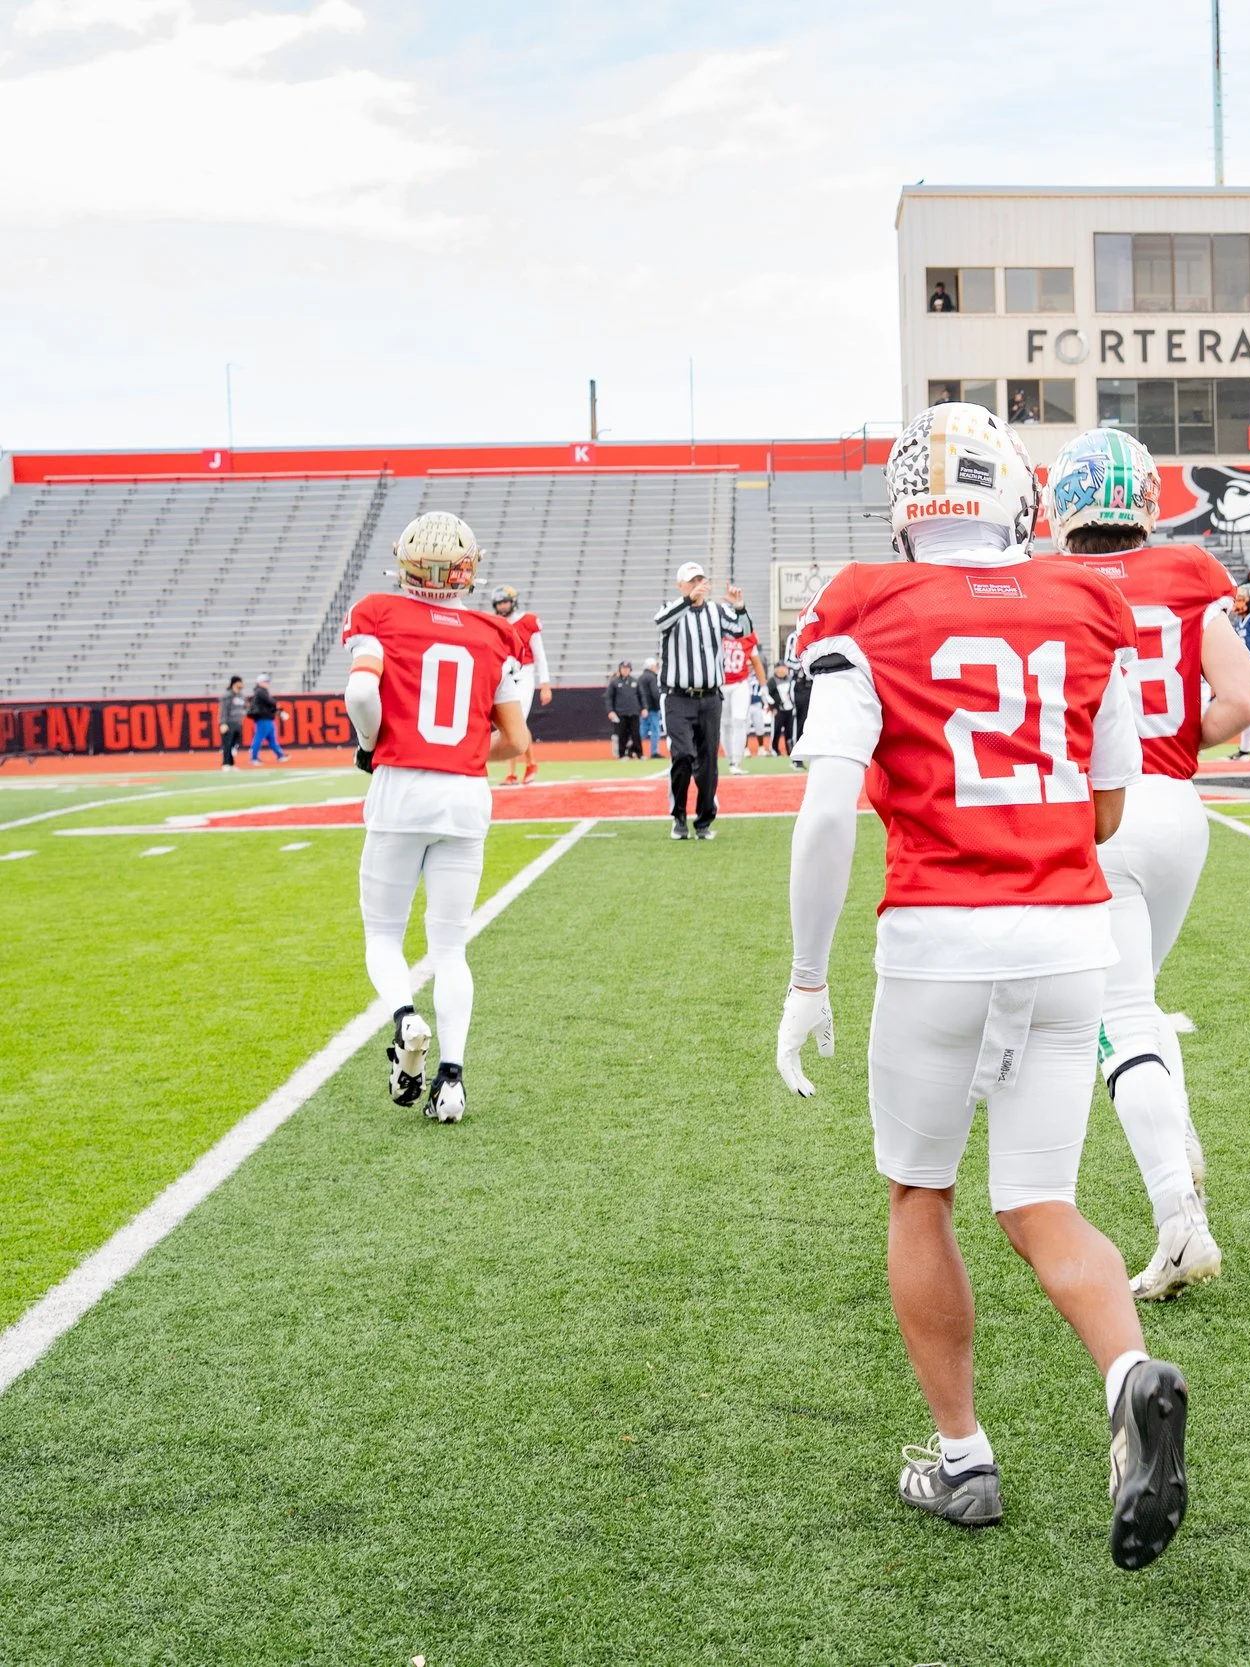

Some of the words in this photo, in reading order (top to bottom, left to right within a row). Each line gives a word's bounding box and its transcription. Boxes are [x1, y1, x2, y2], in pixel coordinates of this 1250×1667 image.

[208, 451, 222, 469] J
[575, 445, 590, 462] K
[906, 499, 980, 520] Riddell
[1099, 511, 1115, 519] THE
[1118, 511, 1135, 521] HILL
[417, 642, 475, 747] 0
[930, 635, 1091, 808] 21
